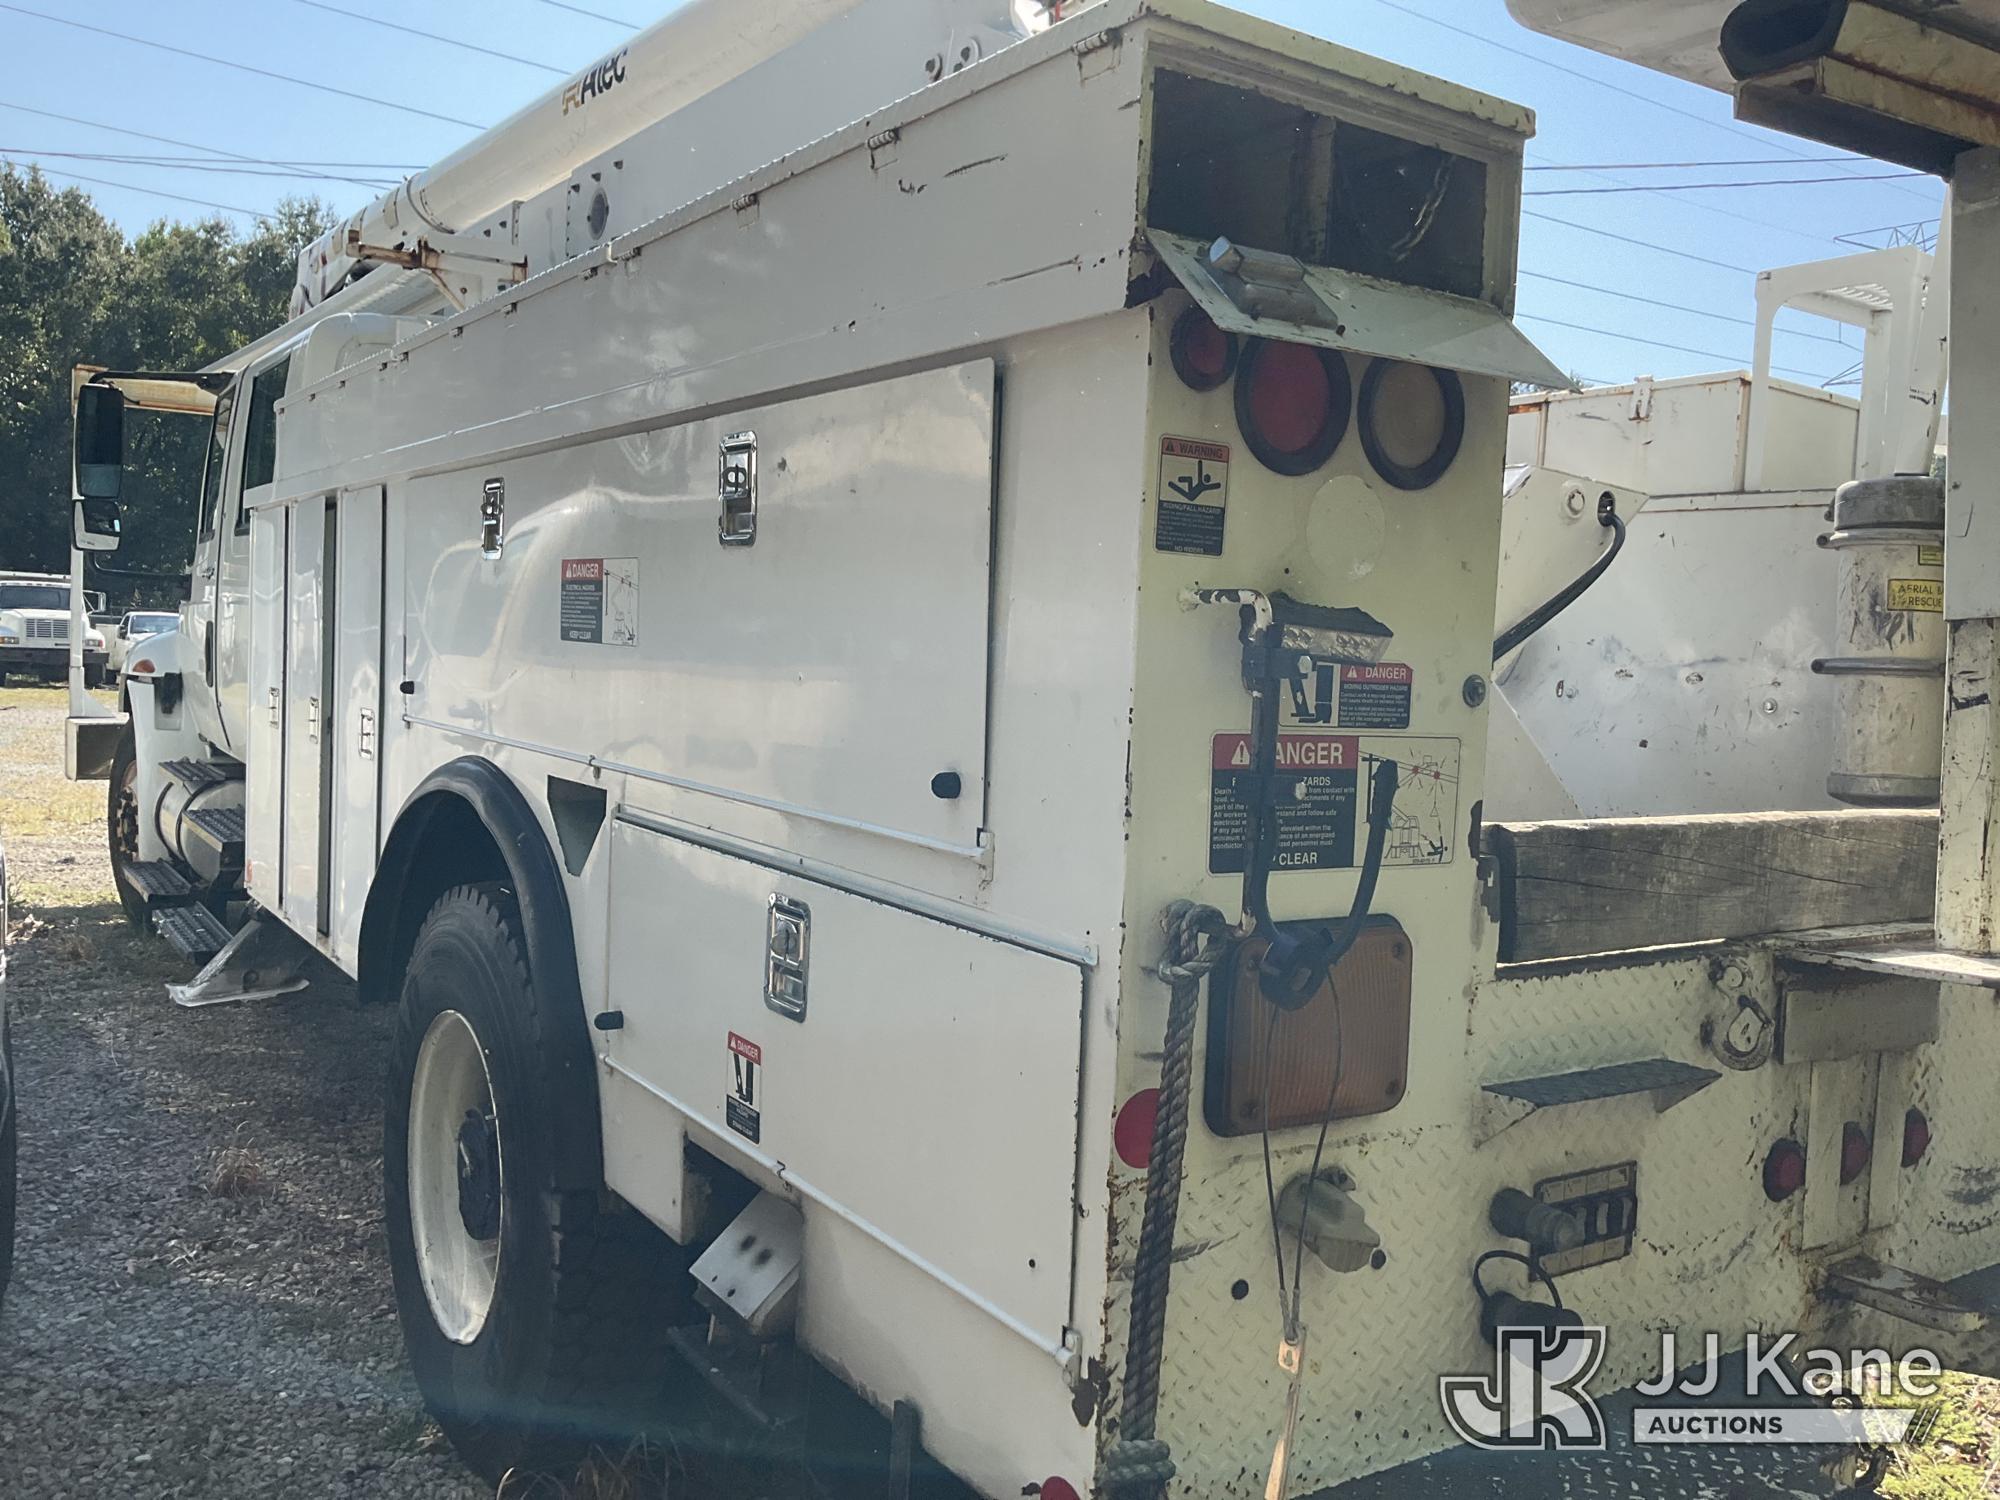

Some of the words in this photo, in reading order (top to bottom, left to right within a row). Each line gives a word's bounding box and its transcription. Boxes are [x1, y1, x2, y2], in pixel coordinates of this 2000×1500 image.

[1179, 443, 1224, 459] WARNING
[572, 563, 599, 578] DANGER
[1898, 585, 1933, 594] AERIAL
[1908, 596, 1942, 607] RESCUE
[1365, 667, 1407, 679] DANGER
[1276, 742, 1344, 765] ANGER
[1303, 776, 1331, 786] ZARDS
[1278, 852, 1318, 865] CLEAR
[737, 1039, 759, 1060] DANGER
